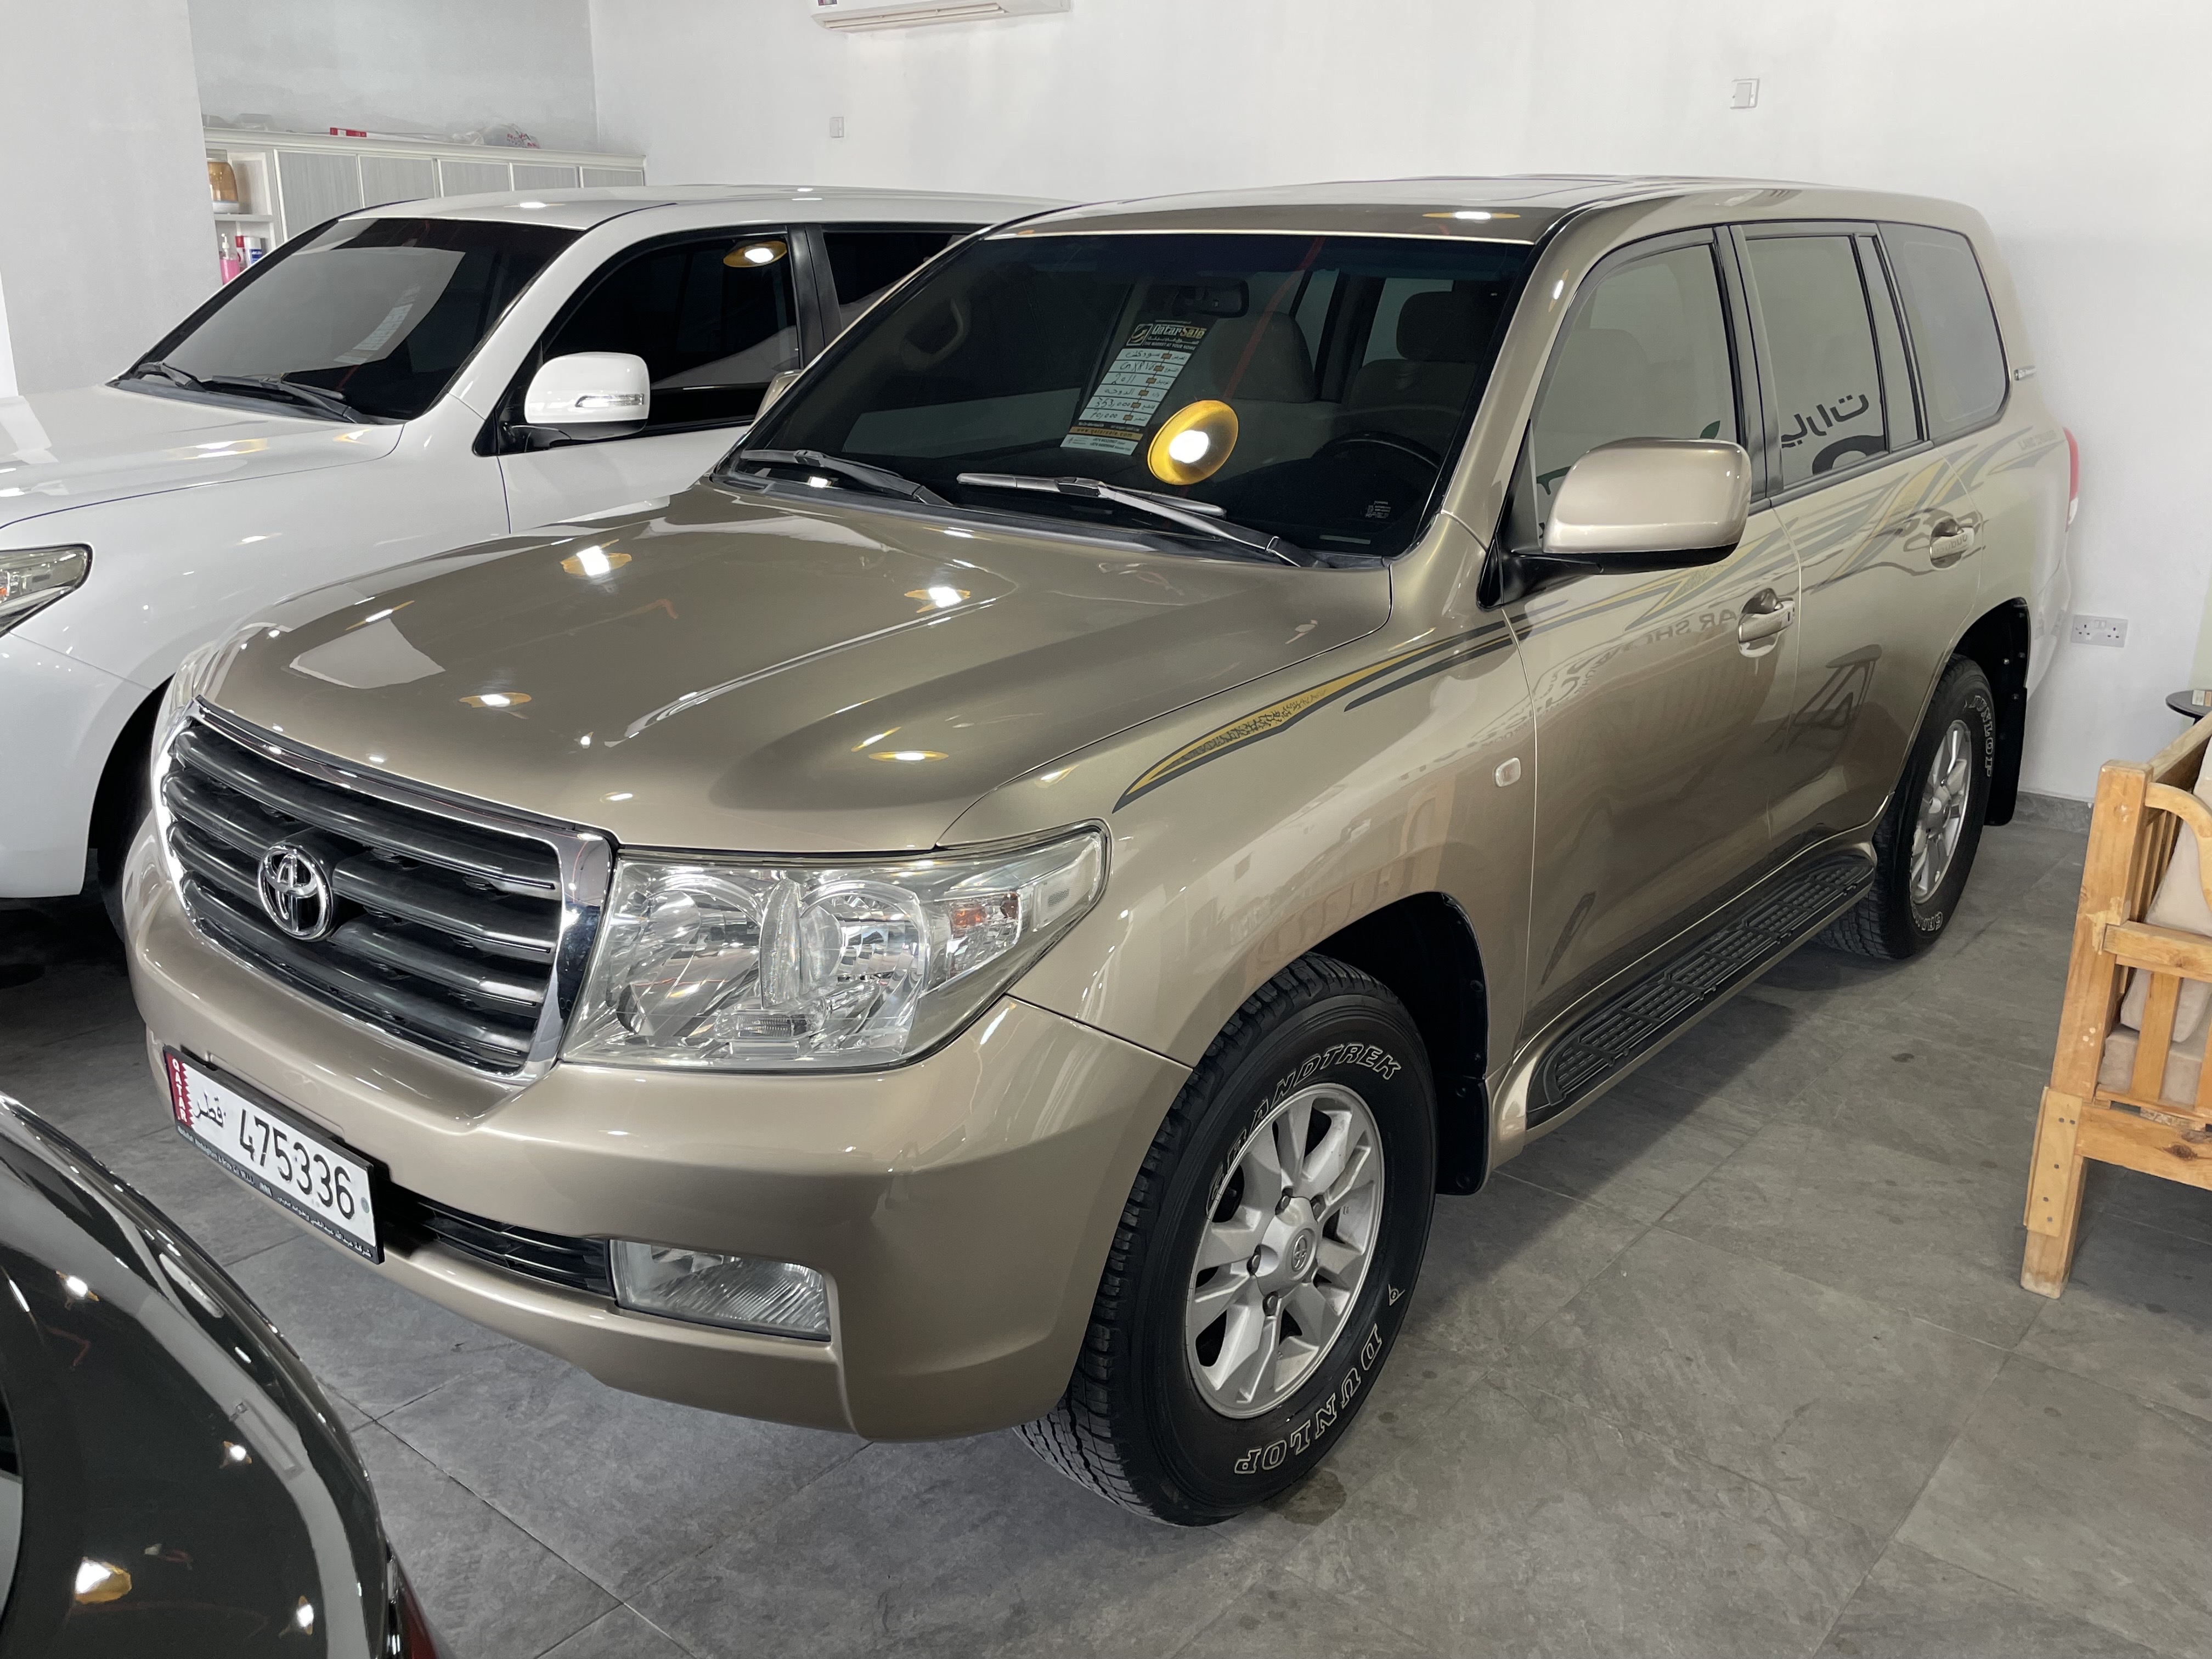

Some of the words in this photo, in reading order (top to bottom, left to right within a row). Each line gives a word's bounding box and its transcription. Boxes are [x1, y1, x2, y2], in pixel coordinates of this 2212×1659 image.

[1111, 372, 1137, 385] 2011
[172, 1058, 188, 1123] QATAR
[193, 1090, 227, 1128] قطر
[239, 1109, 356, 1220] 475336
[1234, 1323, 1381, 1474] DUNLOP
